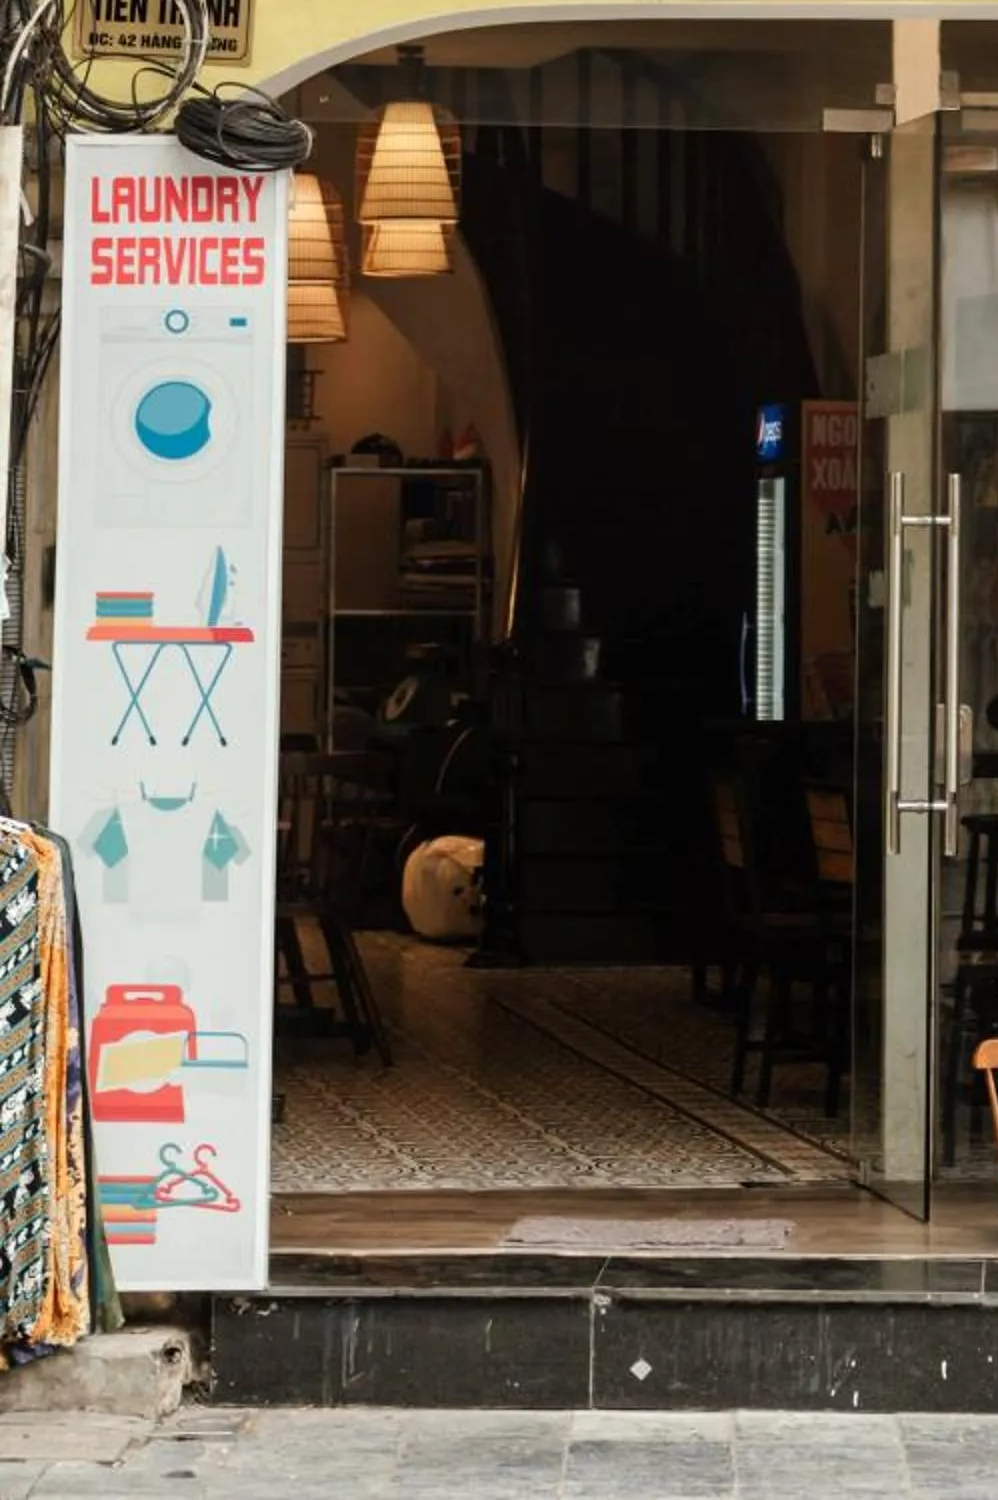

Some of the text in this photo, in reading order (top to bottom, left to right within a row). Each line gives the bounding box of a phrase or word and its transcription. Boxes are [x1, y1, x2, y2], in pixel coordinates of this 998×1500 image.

[117, 33, 137, 48] 42
[90, 176, 265, 224] LAUNDRY
[89, 237, 265, 285] SERVICES
